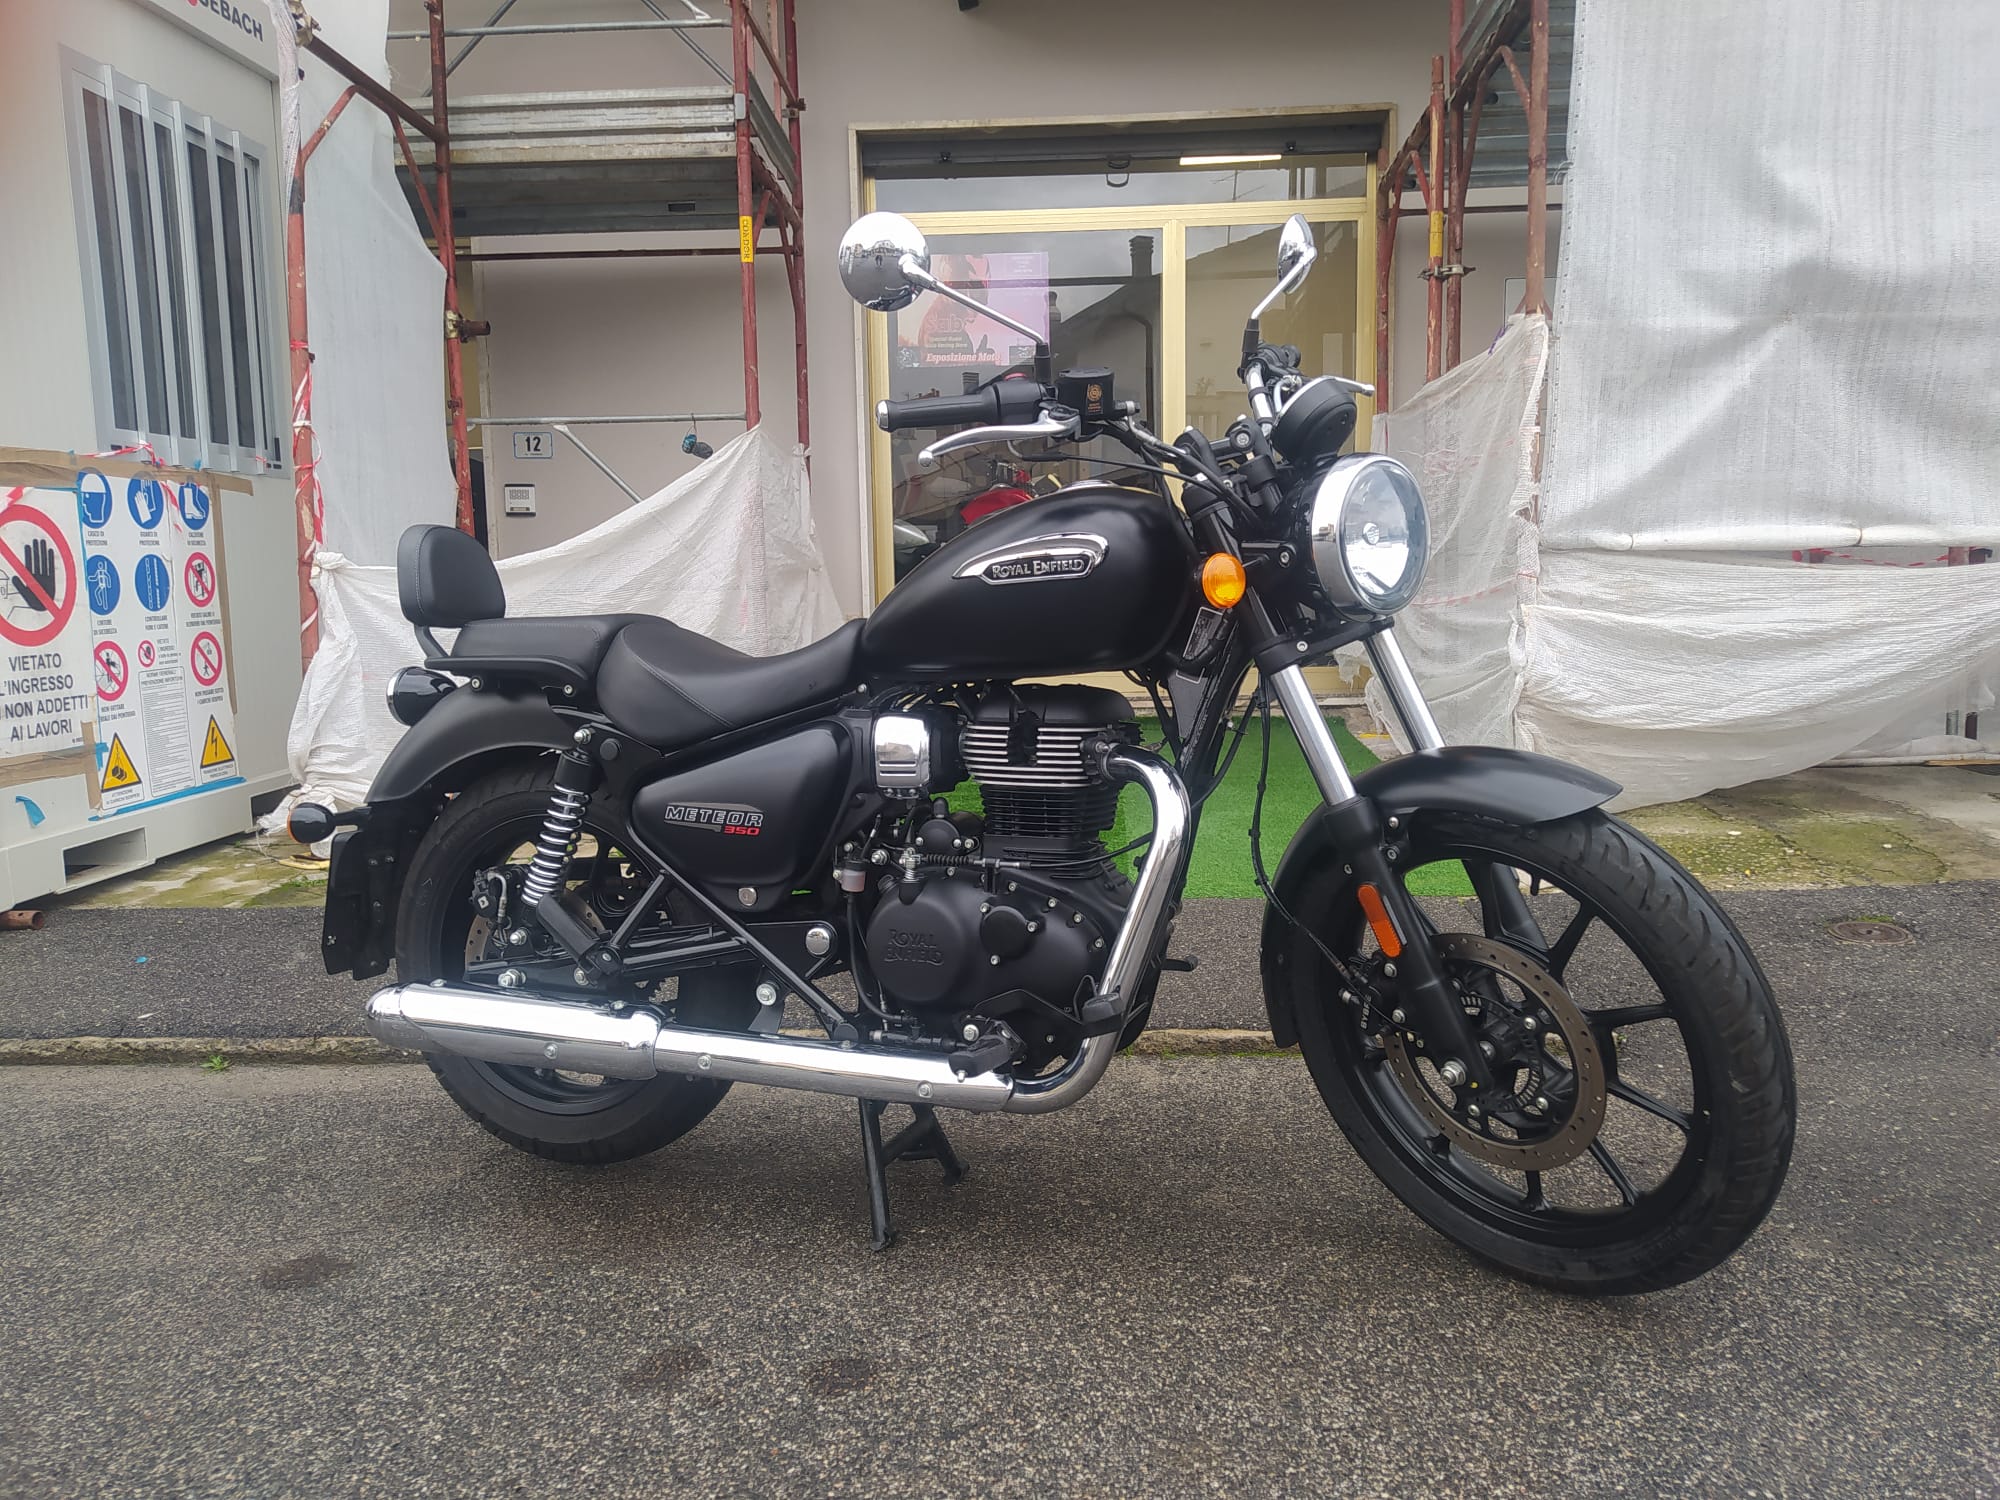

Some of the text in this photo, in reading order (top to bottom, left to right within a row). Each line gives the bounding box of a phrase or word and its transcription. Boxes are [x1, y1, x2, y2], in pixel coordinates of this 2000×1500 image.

[926, 352, 978, 365] Esposizione
[525, 436, 542, 452] 12
[992, 559, 1085, 579] ROYAL ENFIELD
[8, 653, 62, 672] VIETATO
[5, 701, 34, 720] NON
[37, 694, 89, 715] ADDETTI
[10, 718, 72, 742] AI LAVORI
[664, 805, 764, 827] METEOR
[724, 825, 760, 836] 350
[888, 929, 937, 949] ROYAL
[884, 949, 945, 966] ENFIELD
